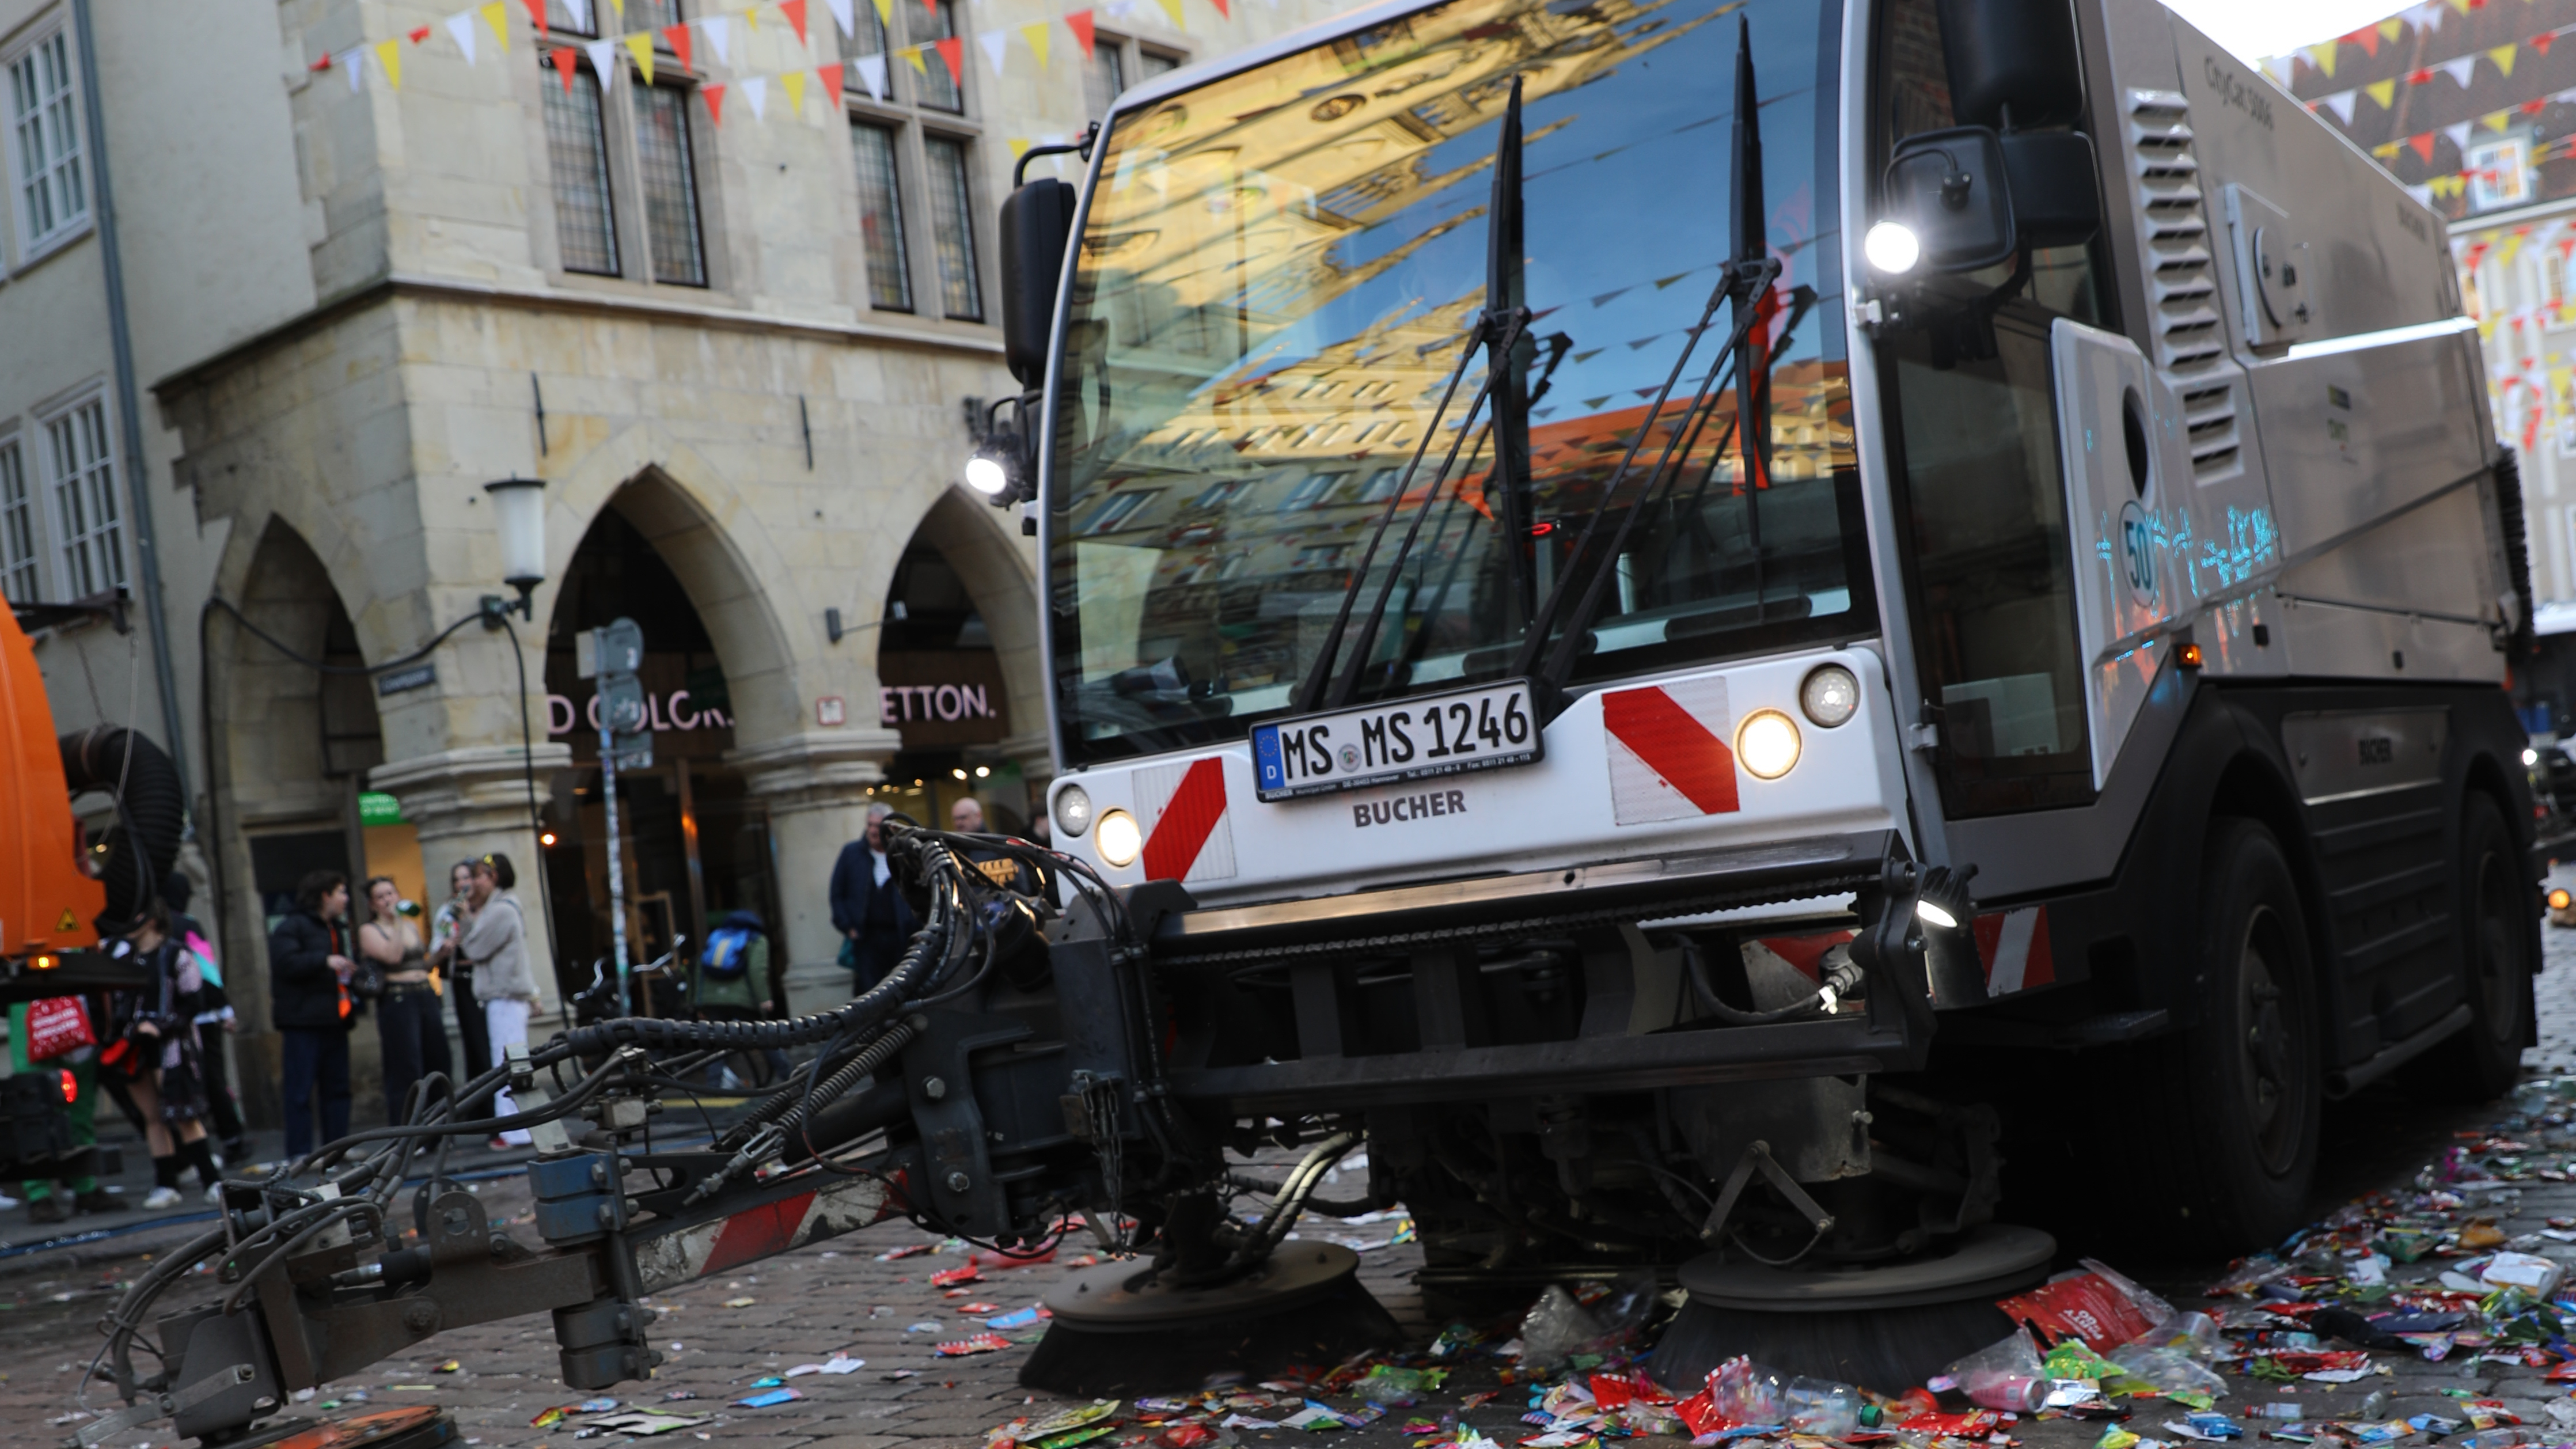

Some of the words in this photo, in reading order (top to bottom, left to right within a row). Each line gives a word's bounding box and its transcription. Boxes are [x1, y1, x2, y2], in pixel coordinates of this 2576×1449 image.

[2124, 520, 2152, 591] 50
[1282, 725, 1333, 779] MS
[1361, 712, 1415, 767] MS
[1423, 692, 1528, 757] 1246
[1266, 764, 1277, 780] D
[1264, 789, 1293, 800] BUCHER
[1353, 789, 1467, 828] BUCHER
